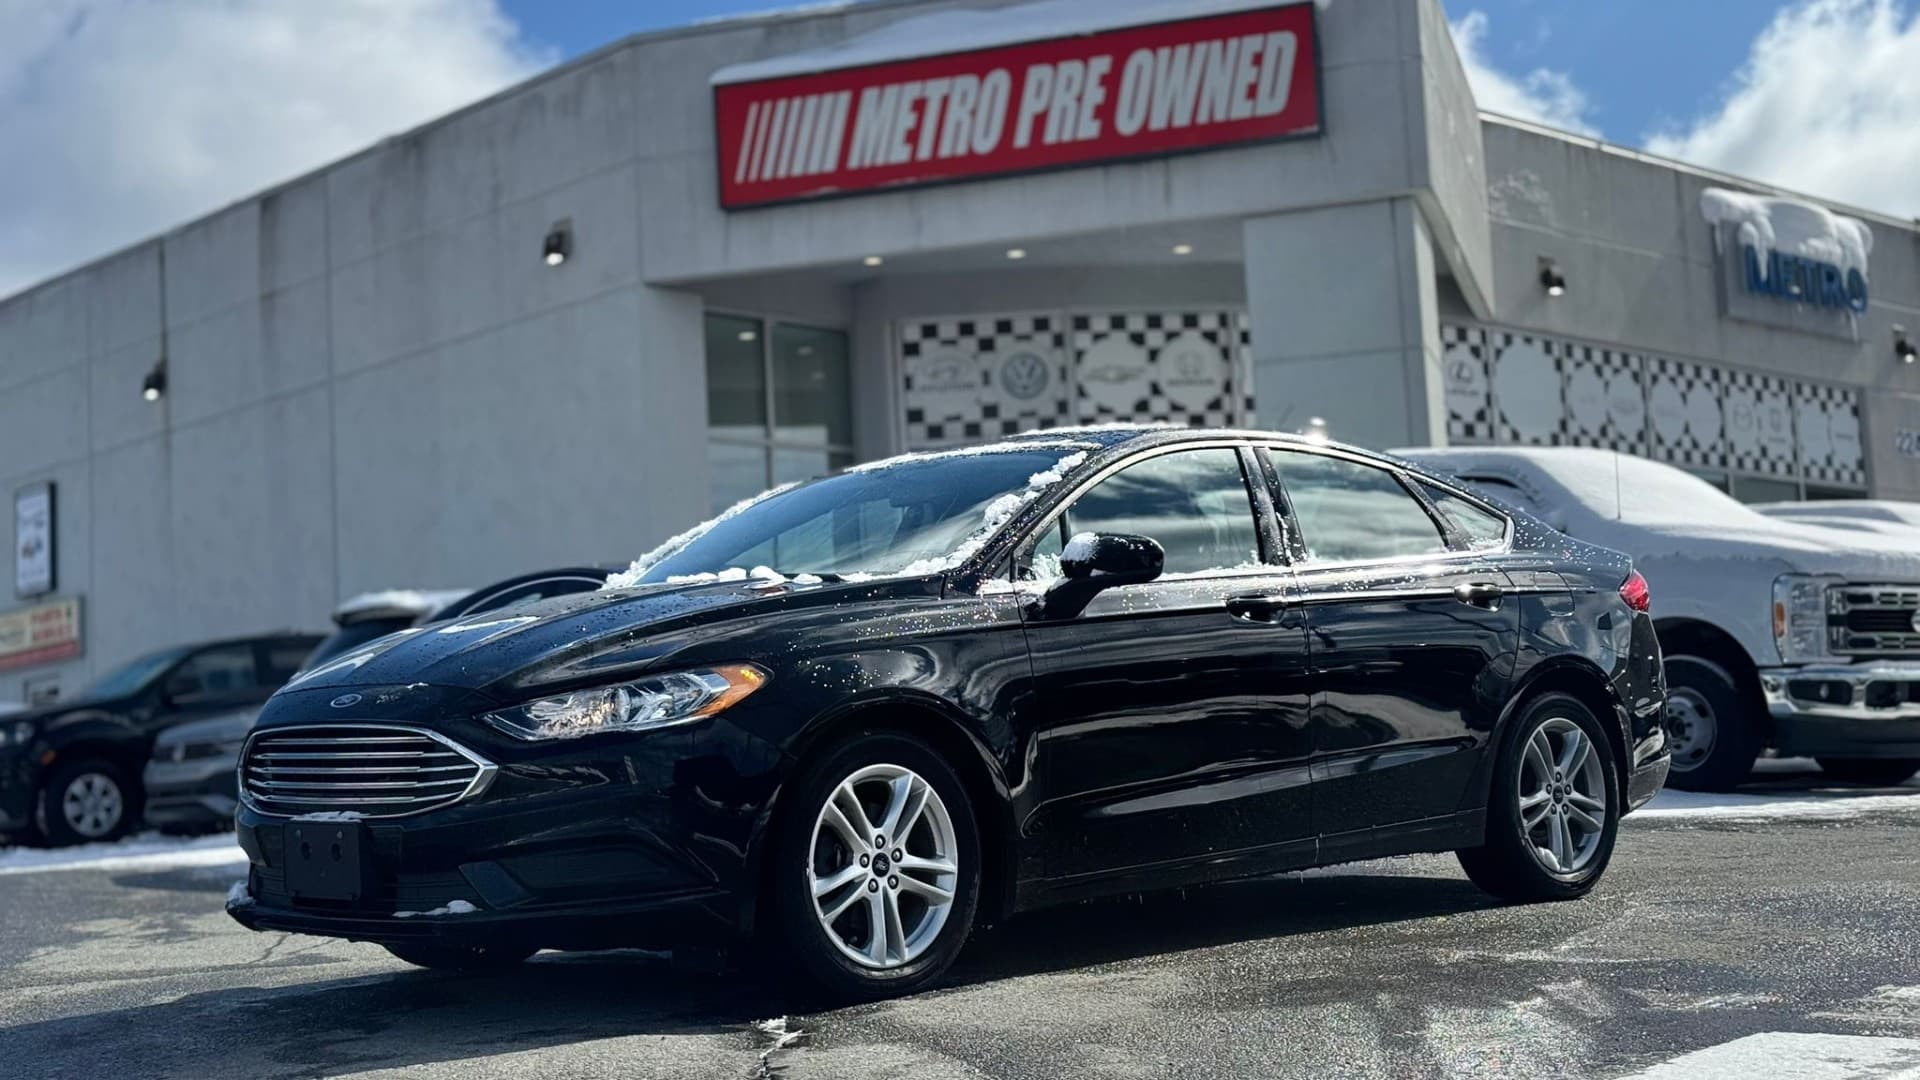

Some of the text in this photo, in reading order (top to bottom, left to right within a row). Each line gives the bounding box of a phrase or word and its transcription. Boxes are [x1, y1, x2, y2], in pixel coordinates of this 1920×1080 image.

[848, 31, 1297, 169] METRO PRE OWNED
[1745, 243, 1868, 314] METRO
